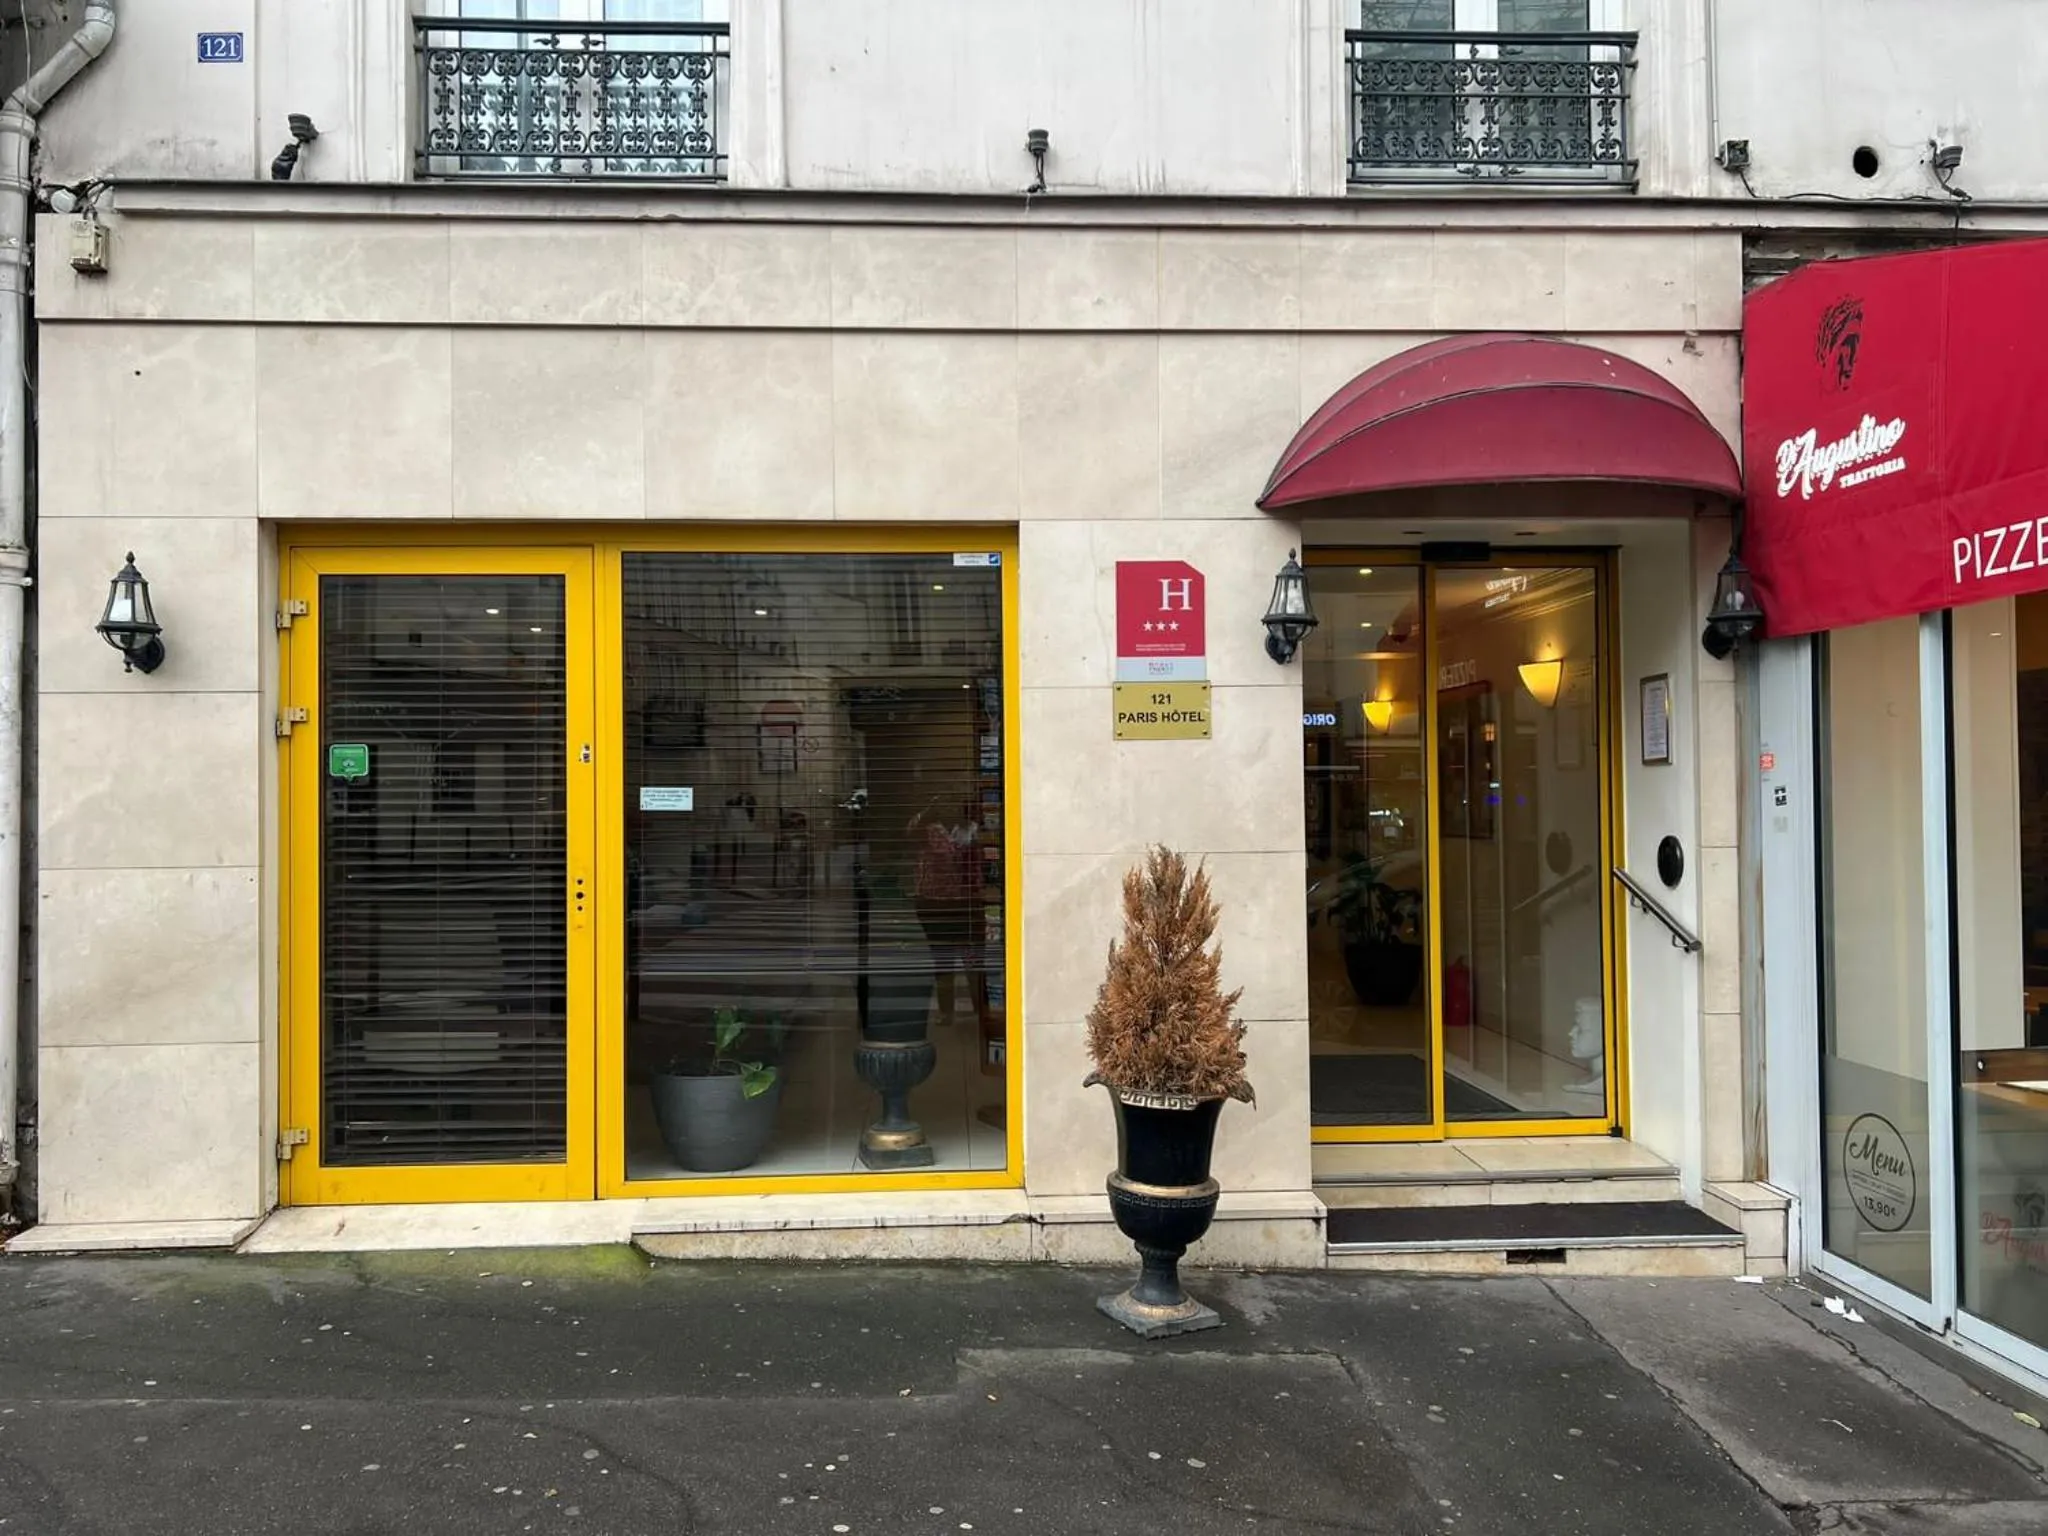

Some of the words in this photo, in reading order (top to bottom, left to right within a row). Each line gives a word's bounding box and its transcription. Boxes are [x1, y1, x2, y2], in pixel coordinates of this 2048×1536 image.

[203, 37, 238, 57] 121
[1839, 456, 1906, 489] TRATTORIA
[1952, 515, 2048, 584] PIZZE
[1158, 577, 1193, 611] H
[1151, 693, 1172, 705] 121
[1118, 711, 1159, 724] PARIS
[1161, 708, 1206, 723] HÔTEL
[1849, 1133, 1905, 1177] Menu
